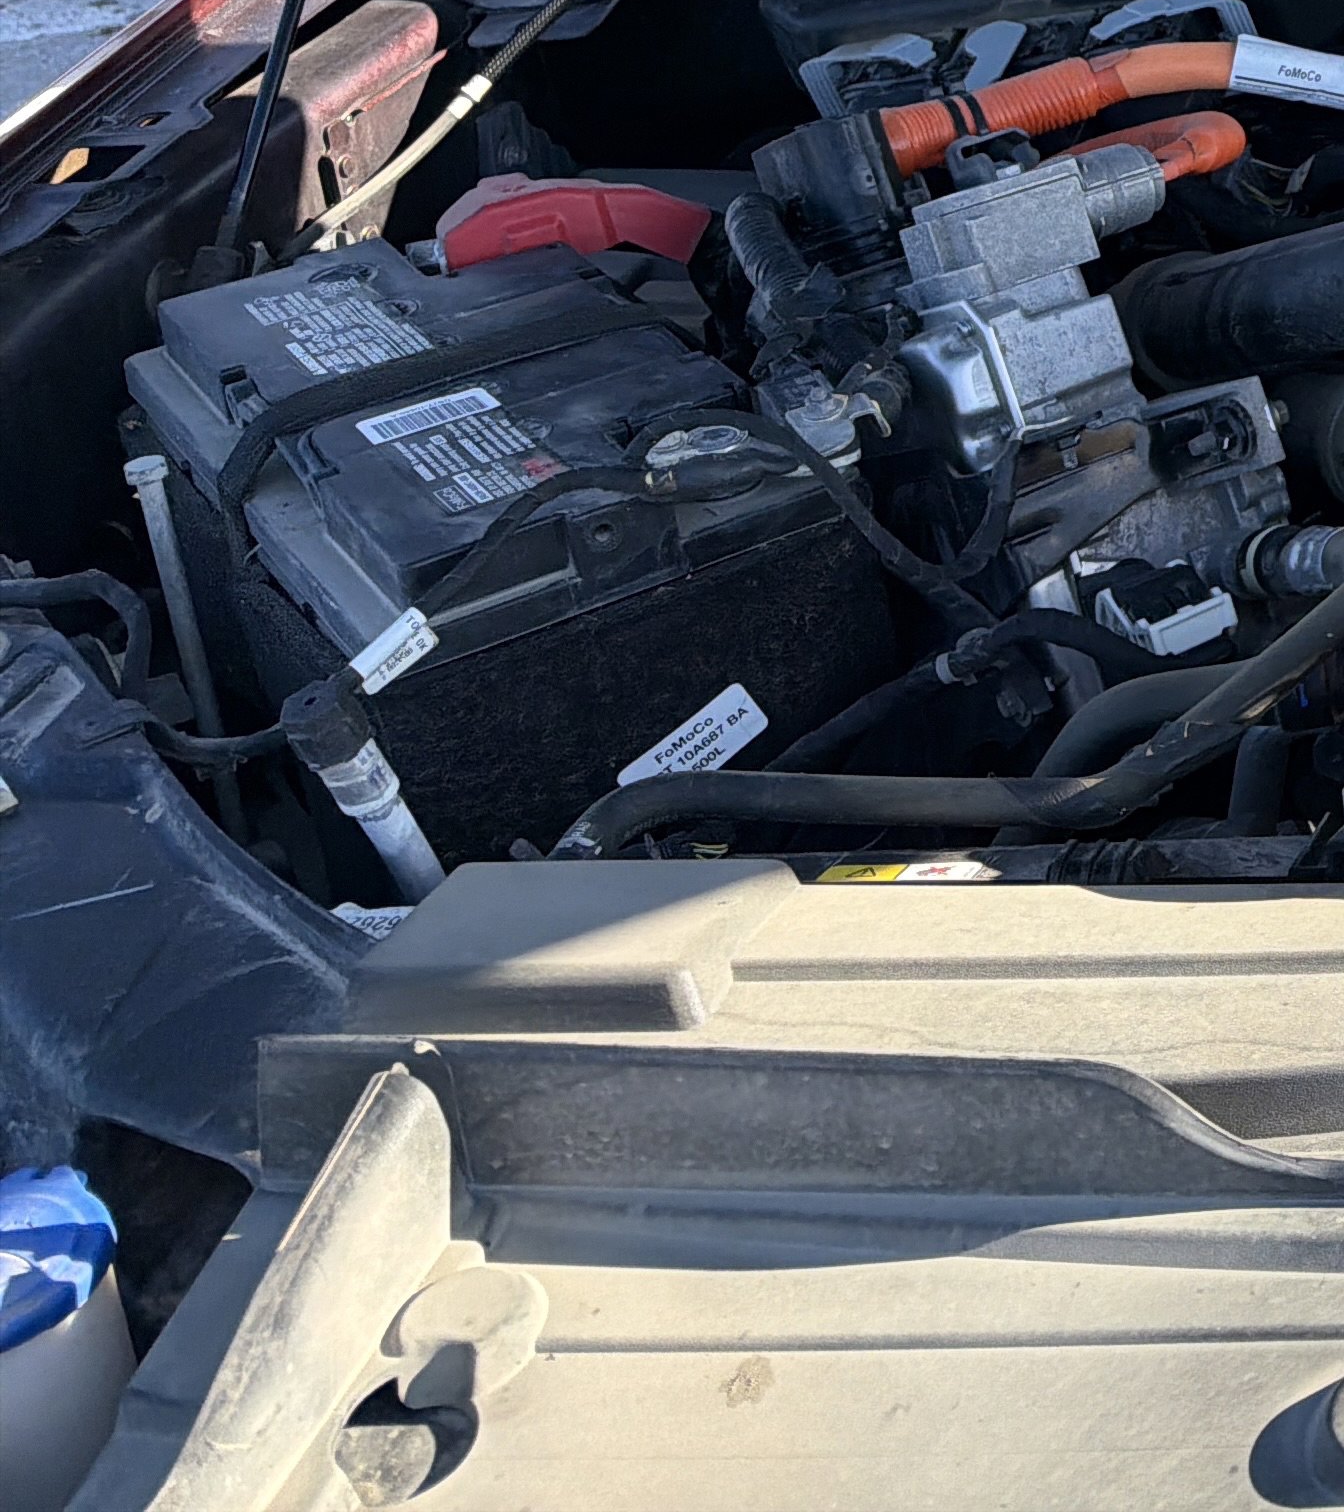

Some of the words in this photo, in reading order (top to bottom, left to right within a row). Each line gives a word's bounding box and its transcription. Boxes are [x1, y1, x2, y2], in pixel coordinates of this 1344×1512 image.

[1277, 65, 1322, 83] FoMoCo
[654, 717, 714, 765] FoMoCo
[677, 724, 725, 766] 10A687
[726, 707, 749, 727] BA
